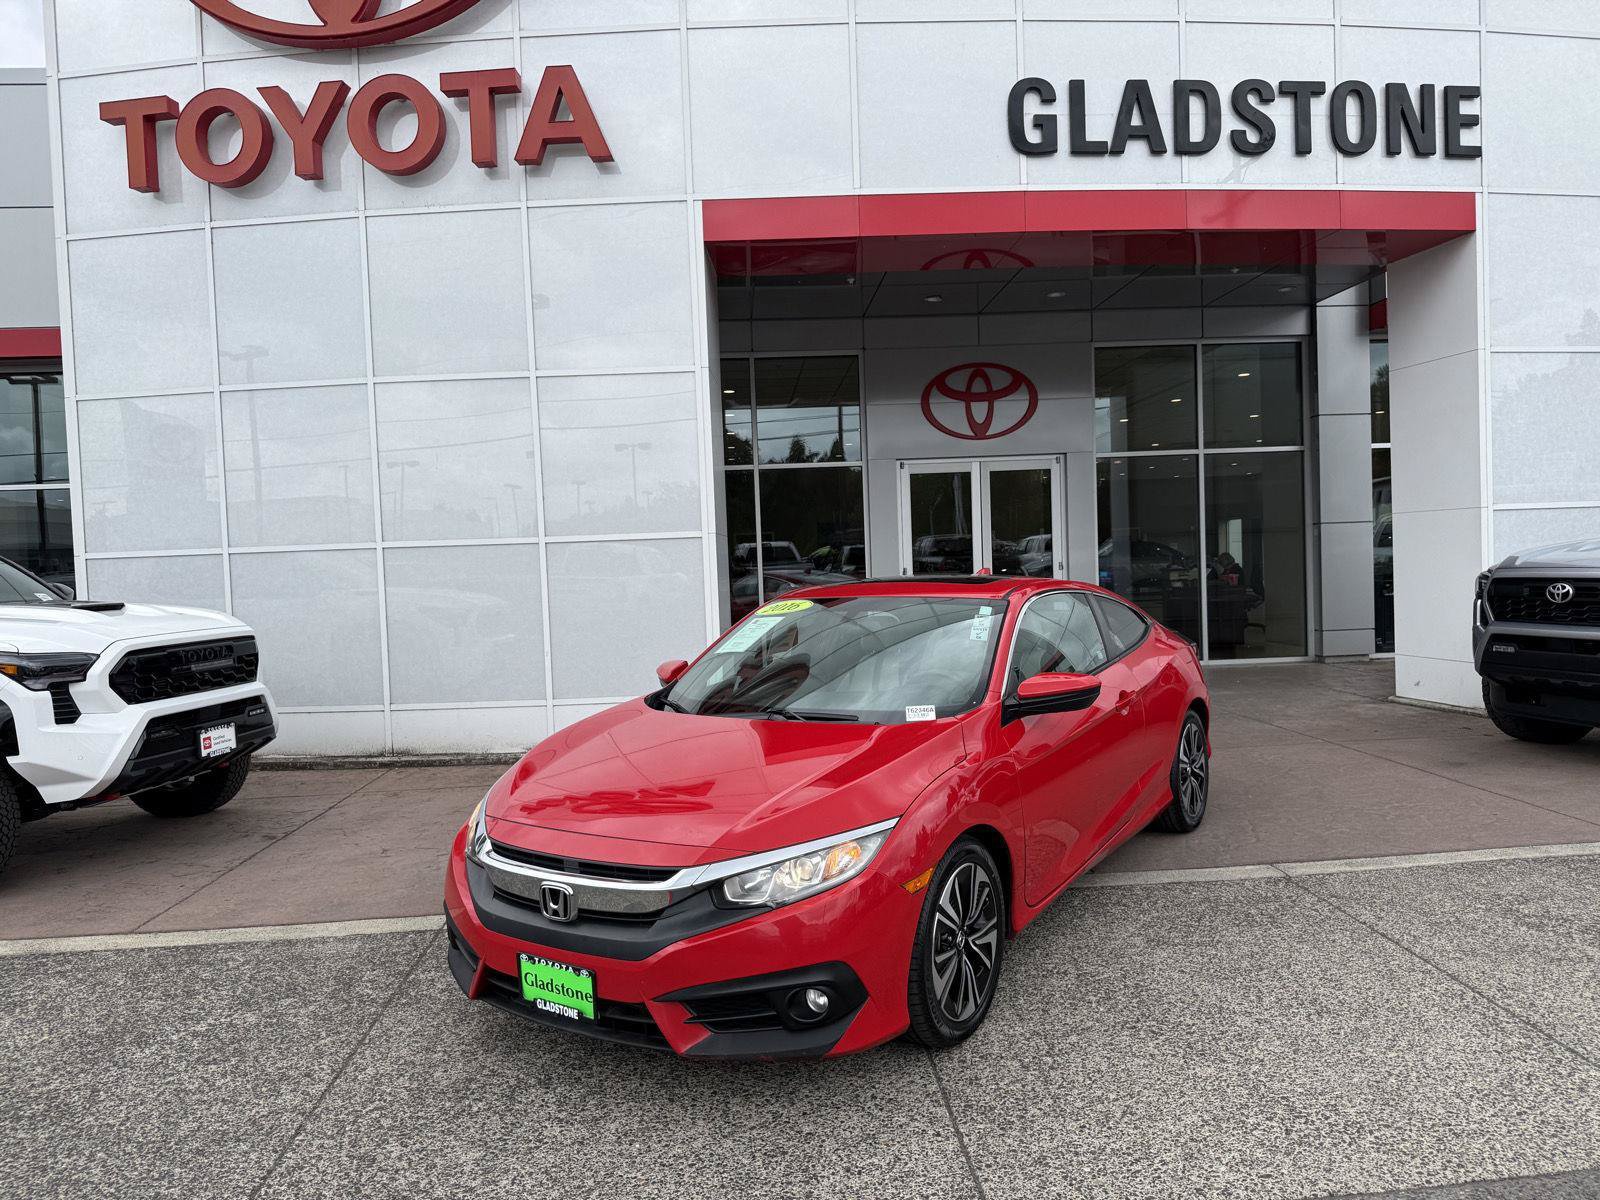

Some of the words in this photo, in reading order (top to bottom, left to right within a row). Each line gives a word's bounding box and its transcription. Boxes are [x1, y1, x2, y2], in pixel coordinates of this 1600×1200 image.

[98, 64, 615, 194] TOYOTA
[1008, 76, 1483, 159] GLADSTONE
[180, 646, 231, 664] TOYOTA
[534, 957, 574, 974] TOYOTA
[524, 971, 593, 1004] Gladstone
[536, 999, 579, 1020] GLADSTONE
